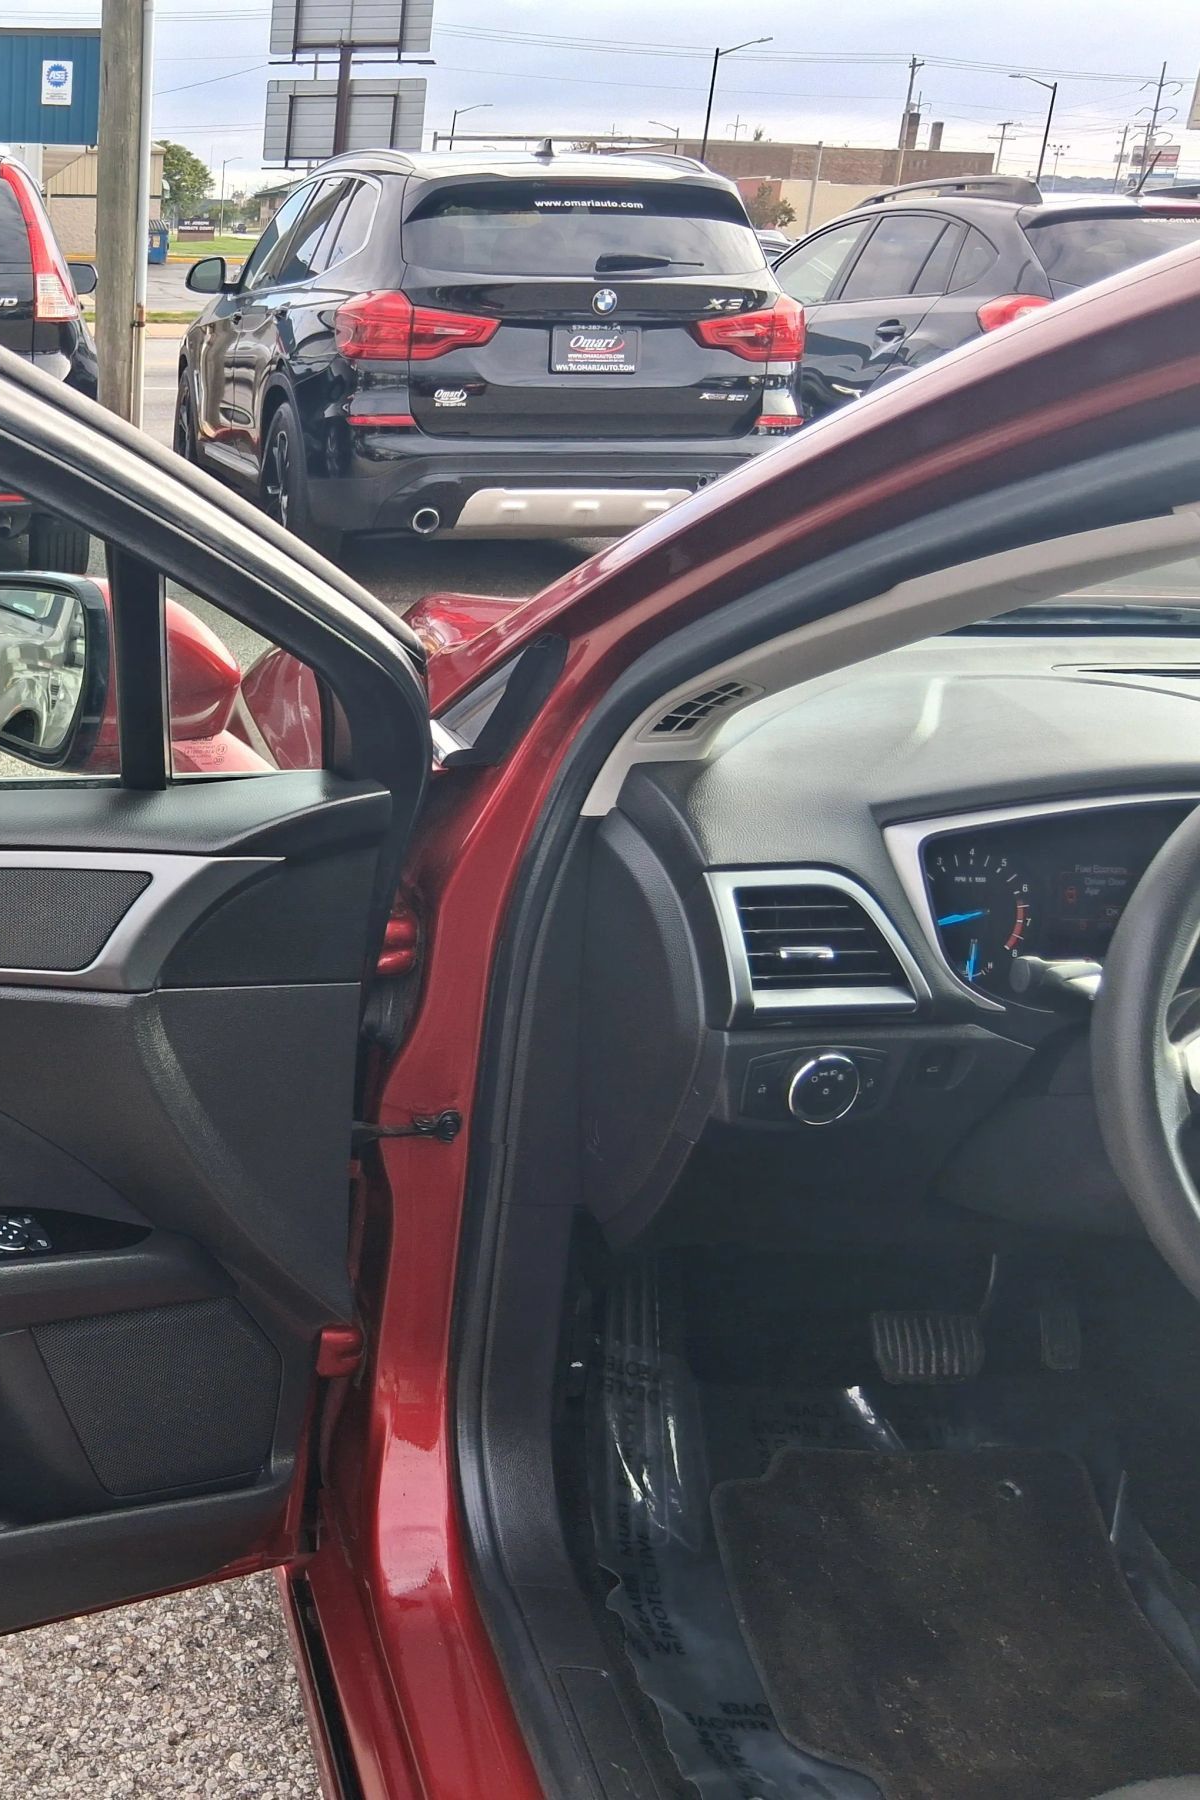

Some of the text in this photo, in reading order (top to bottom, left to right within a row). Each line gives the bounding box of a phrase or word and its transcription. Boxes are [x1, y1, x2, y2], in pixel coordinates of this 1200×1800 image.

[535, 200, 644, 209] www.omariauto.com
[703, 298, 744, 311] X3
[569, 335, 618, 348] Omari
[1001, 858, 1007, 867] 5
[1022, 884, 1028, 892] 6
